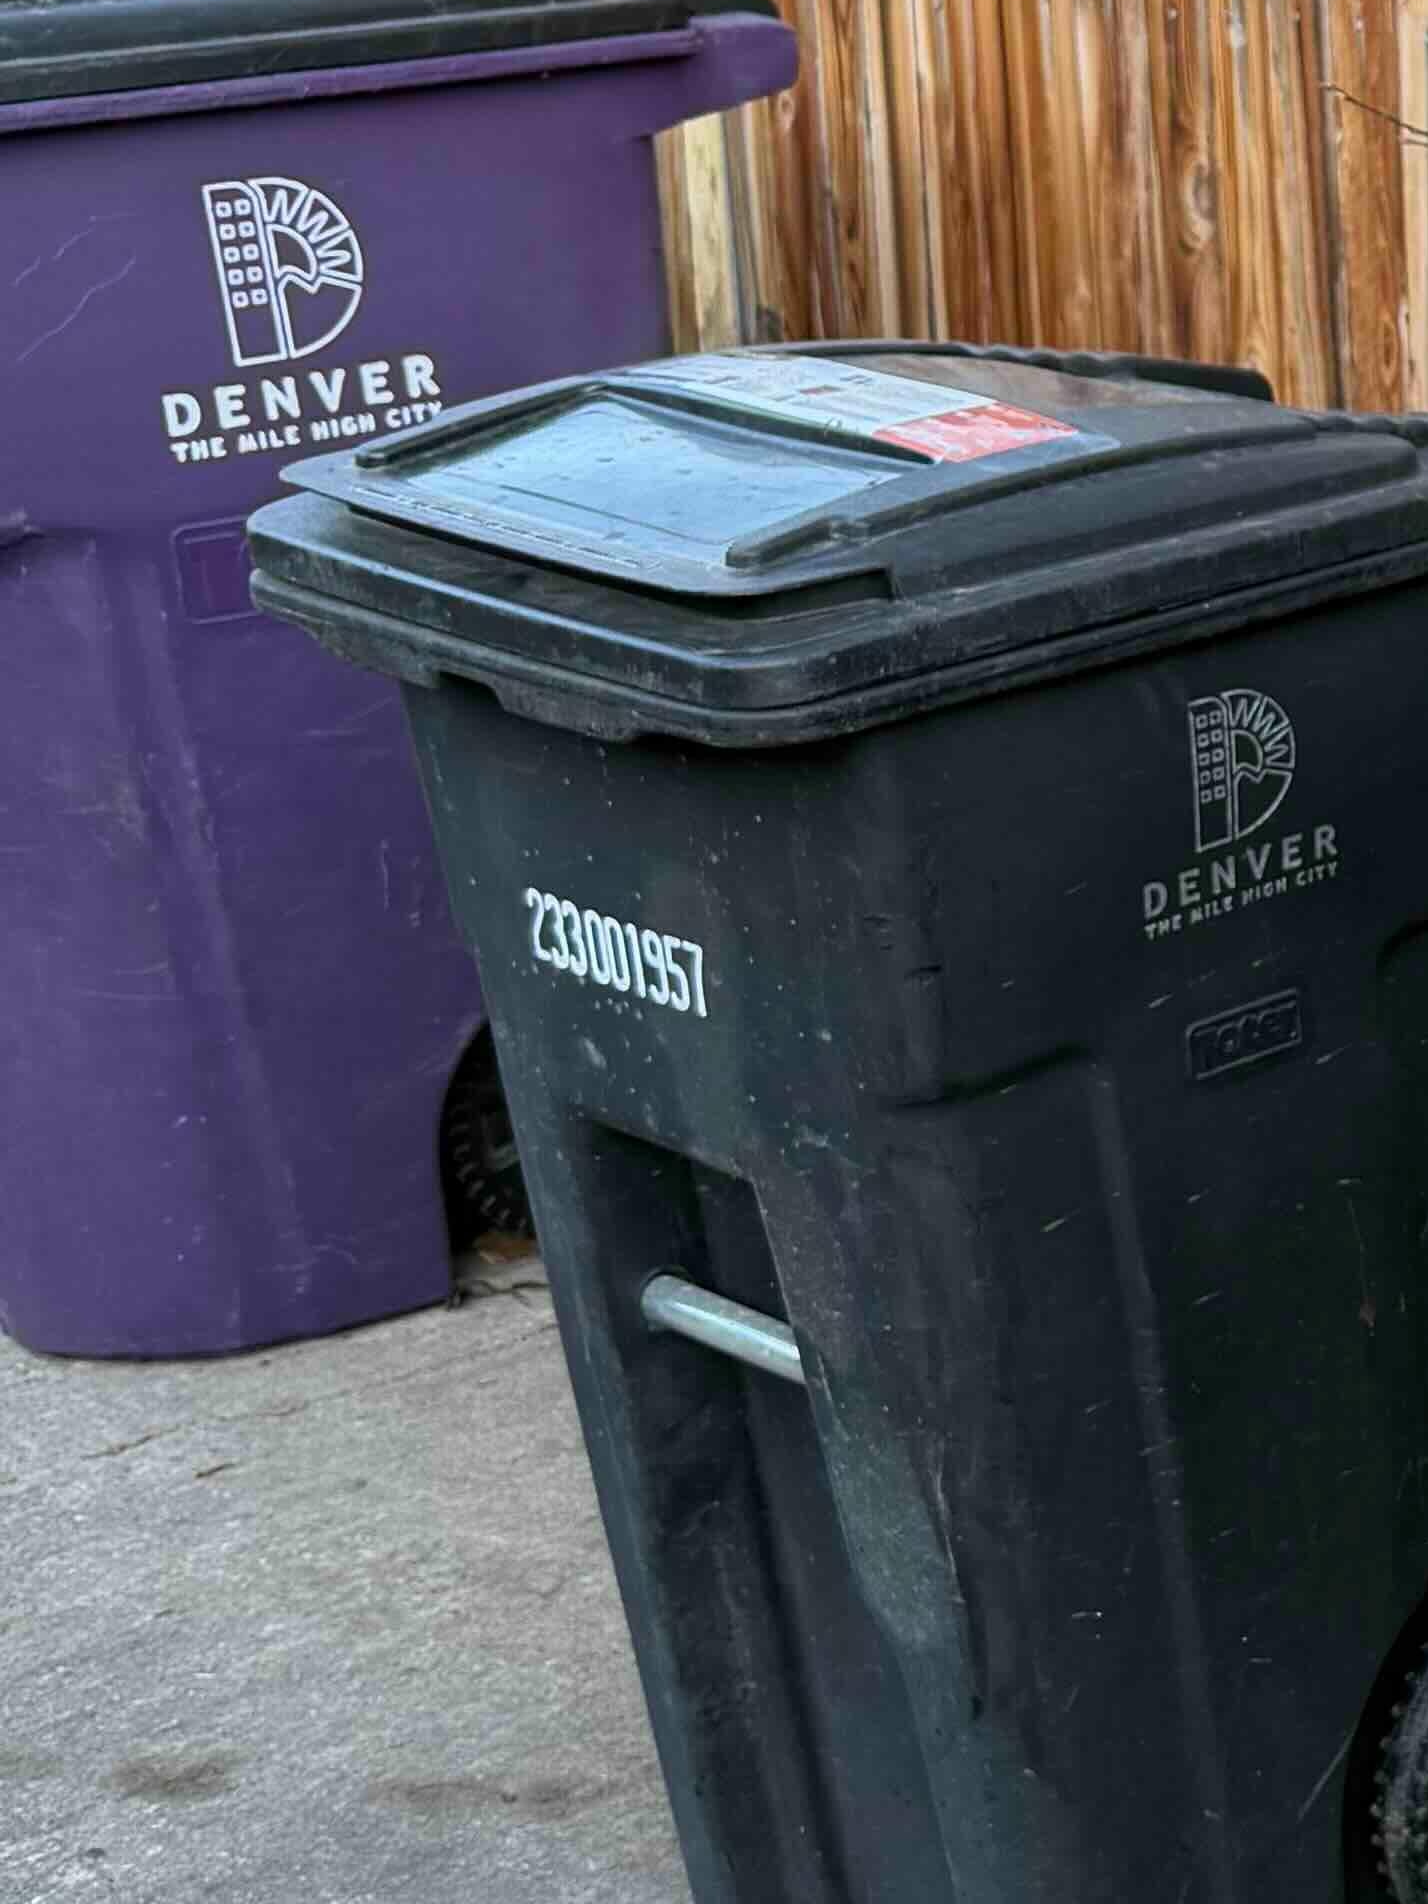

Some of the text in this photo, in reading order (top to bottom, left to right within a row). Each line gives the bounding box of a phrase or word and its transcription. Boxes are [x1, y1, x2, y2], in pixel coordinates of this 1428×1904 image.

[161, 353, 441, 438] DENVER
[169, 400, 443, 464] THE MILE HIGH CITY
[1142, 824, 1338, 920] DENVER
[1144, 861, 1339, 940] THE MILE HIGH CITY
[525, 886, 708, 1018] 233001957
